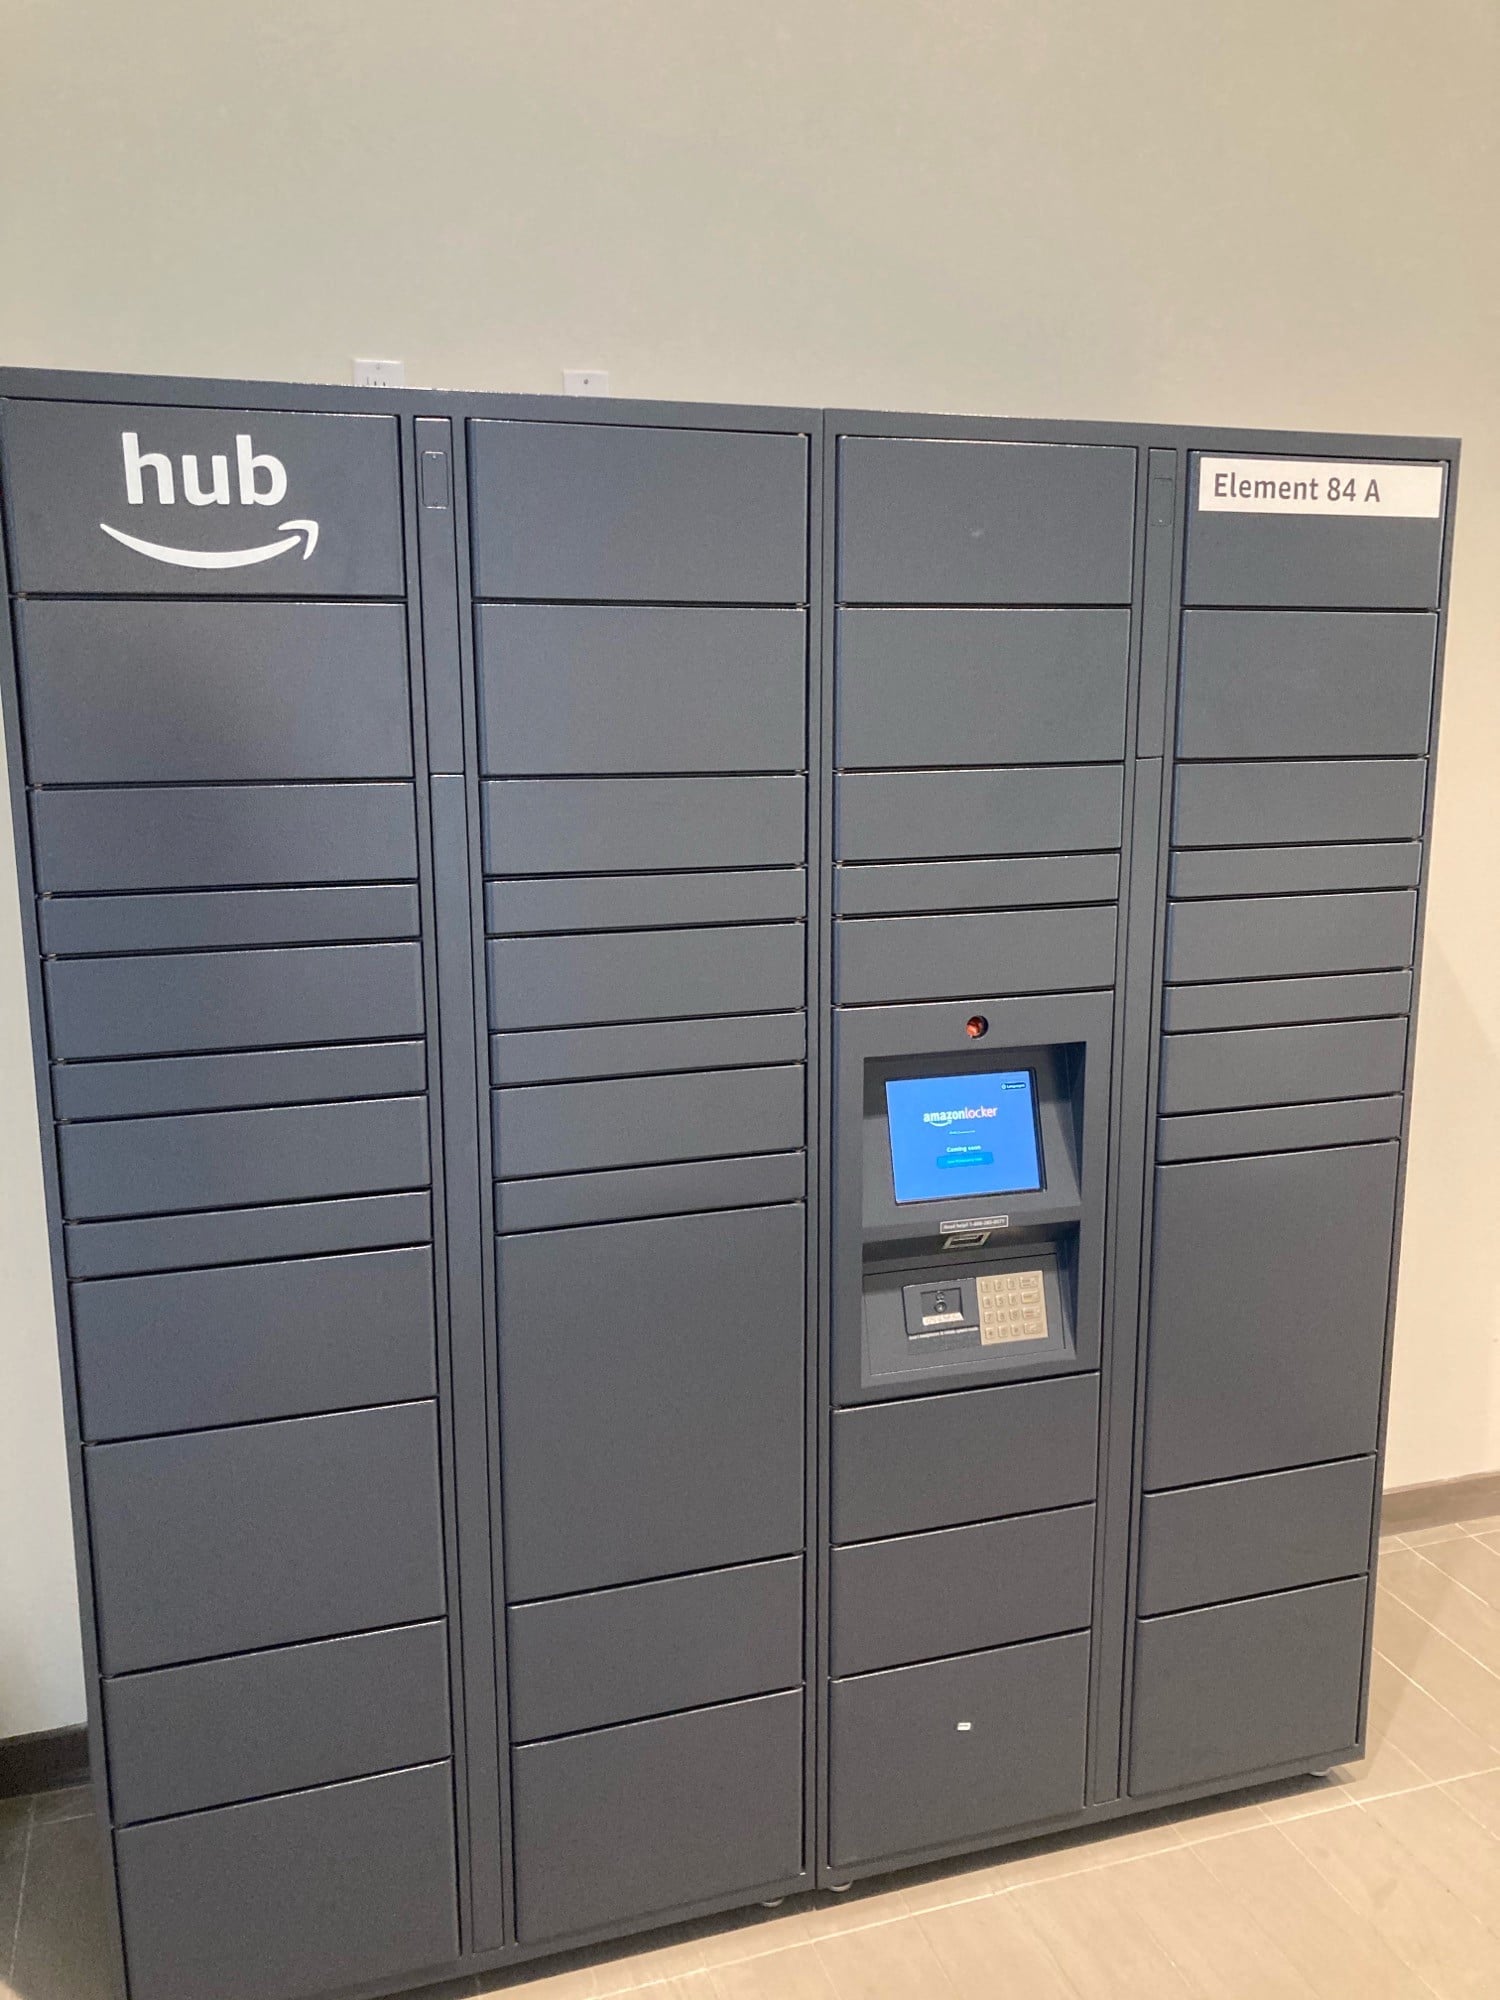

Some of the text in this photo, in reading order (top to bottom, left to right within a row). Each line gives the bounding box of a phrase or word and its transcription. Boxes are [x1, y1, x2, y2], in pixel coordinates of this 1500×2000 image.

[122, 432, 287, 506] hub
[1214, 472, 1381, 503] Element 84 A
